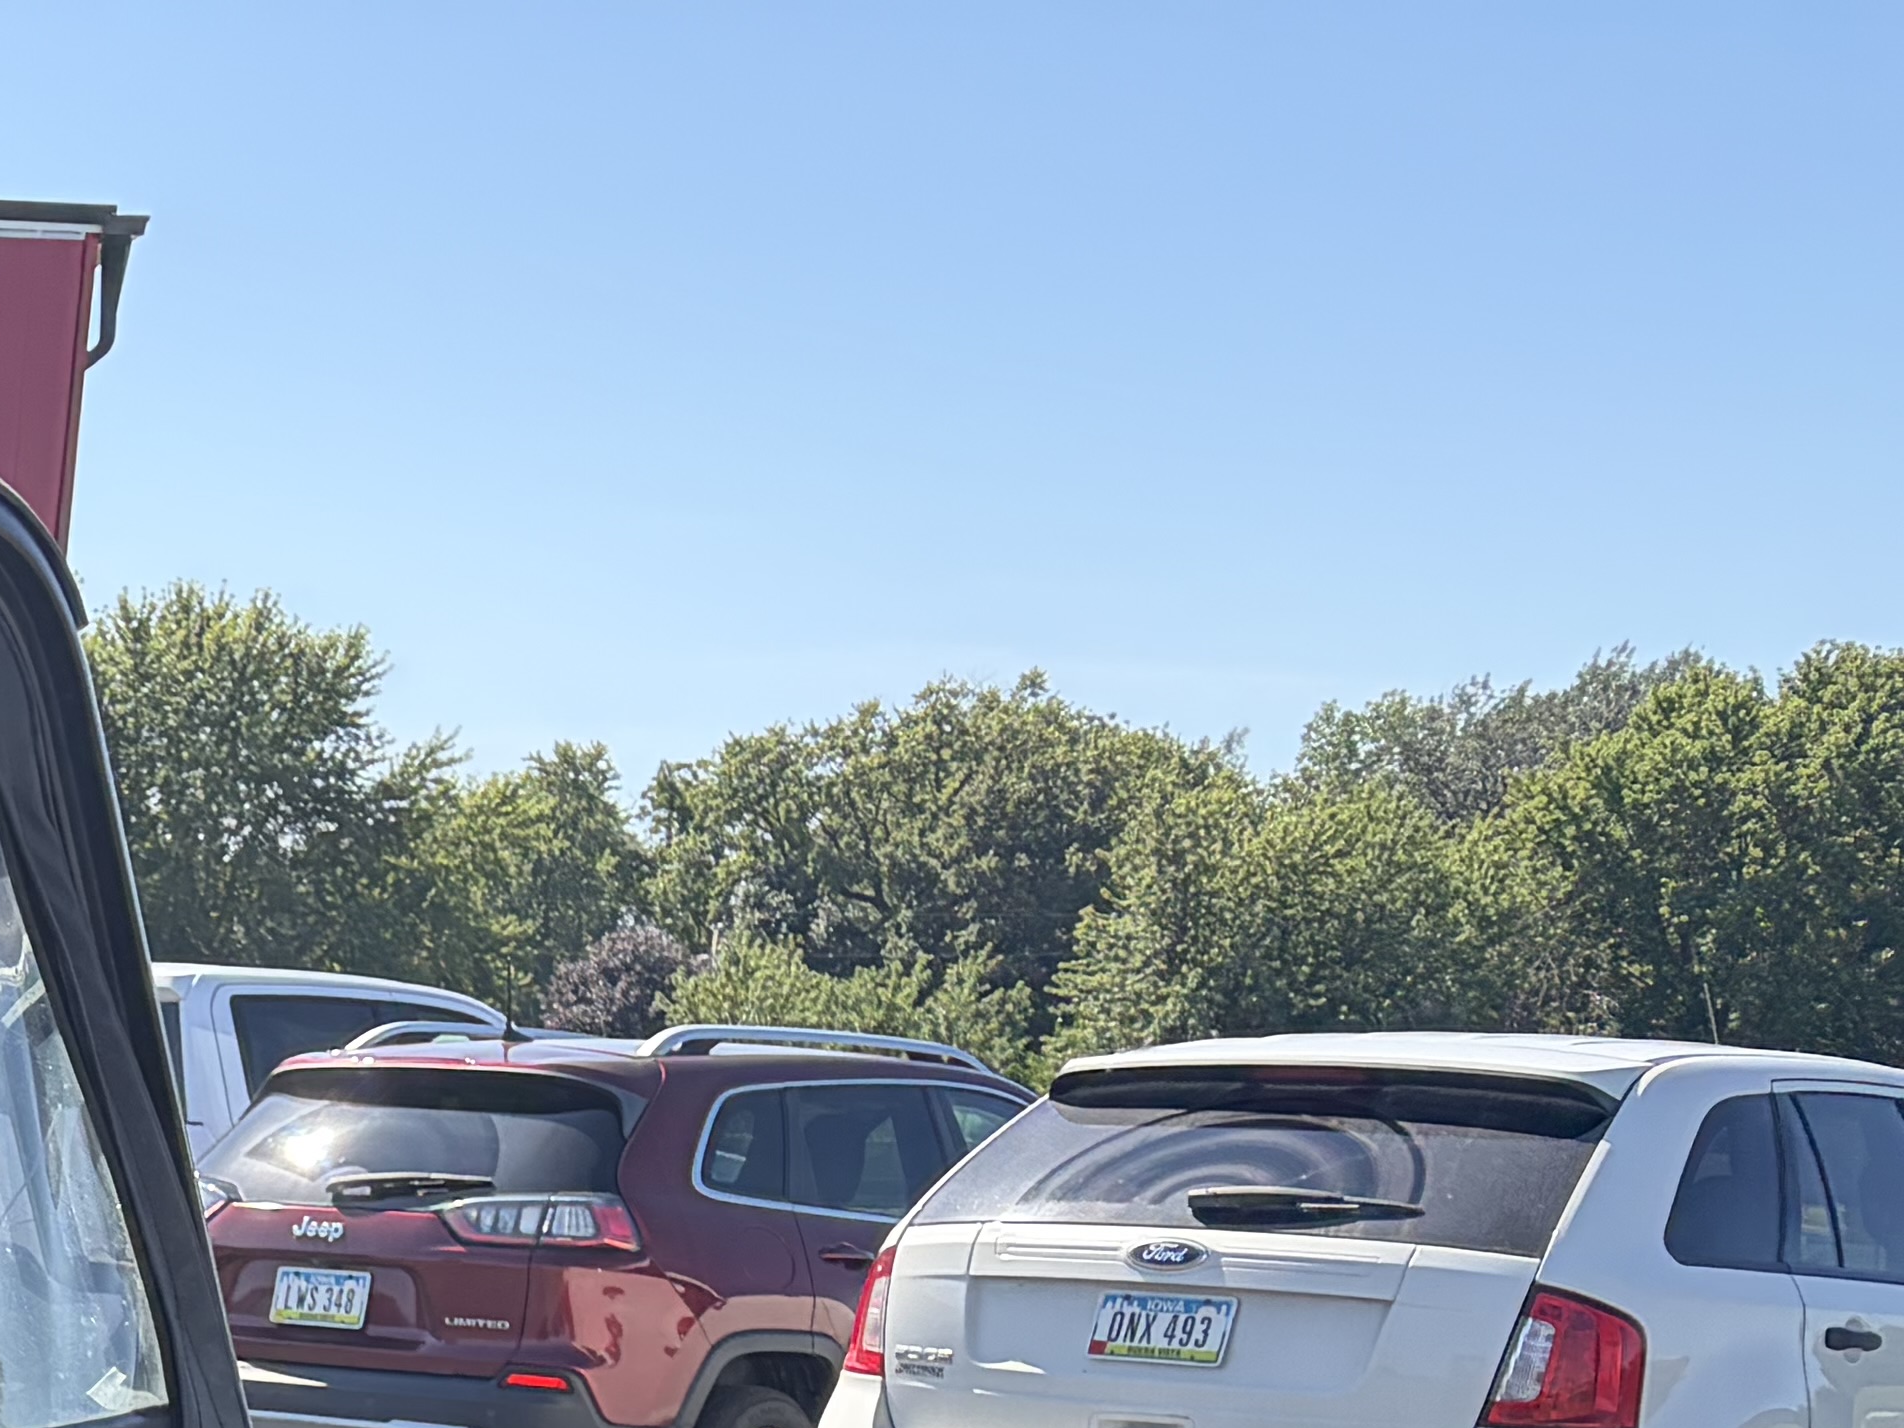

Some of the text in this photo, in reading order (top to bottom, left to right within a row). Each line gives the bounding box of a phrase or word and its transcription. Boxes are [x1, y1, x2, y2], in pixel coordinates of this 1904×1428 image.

[292, 1216, 344, 1242] Jeep
[1141, 1242, 1189, 1262] Ford
[322, 1286, 356, 1314] 348
[1147, 1299, 1185, 1314] IOWA
[444, 1317, 511, 1331] LIMITED
[1163, 1314, 1213, 1349] 493
